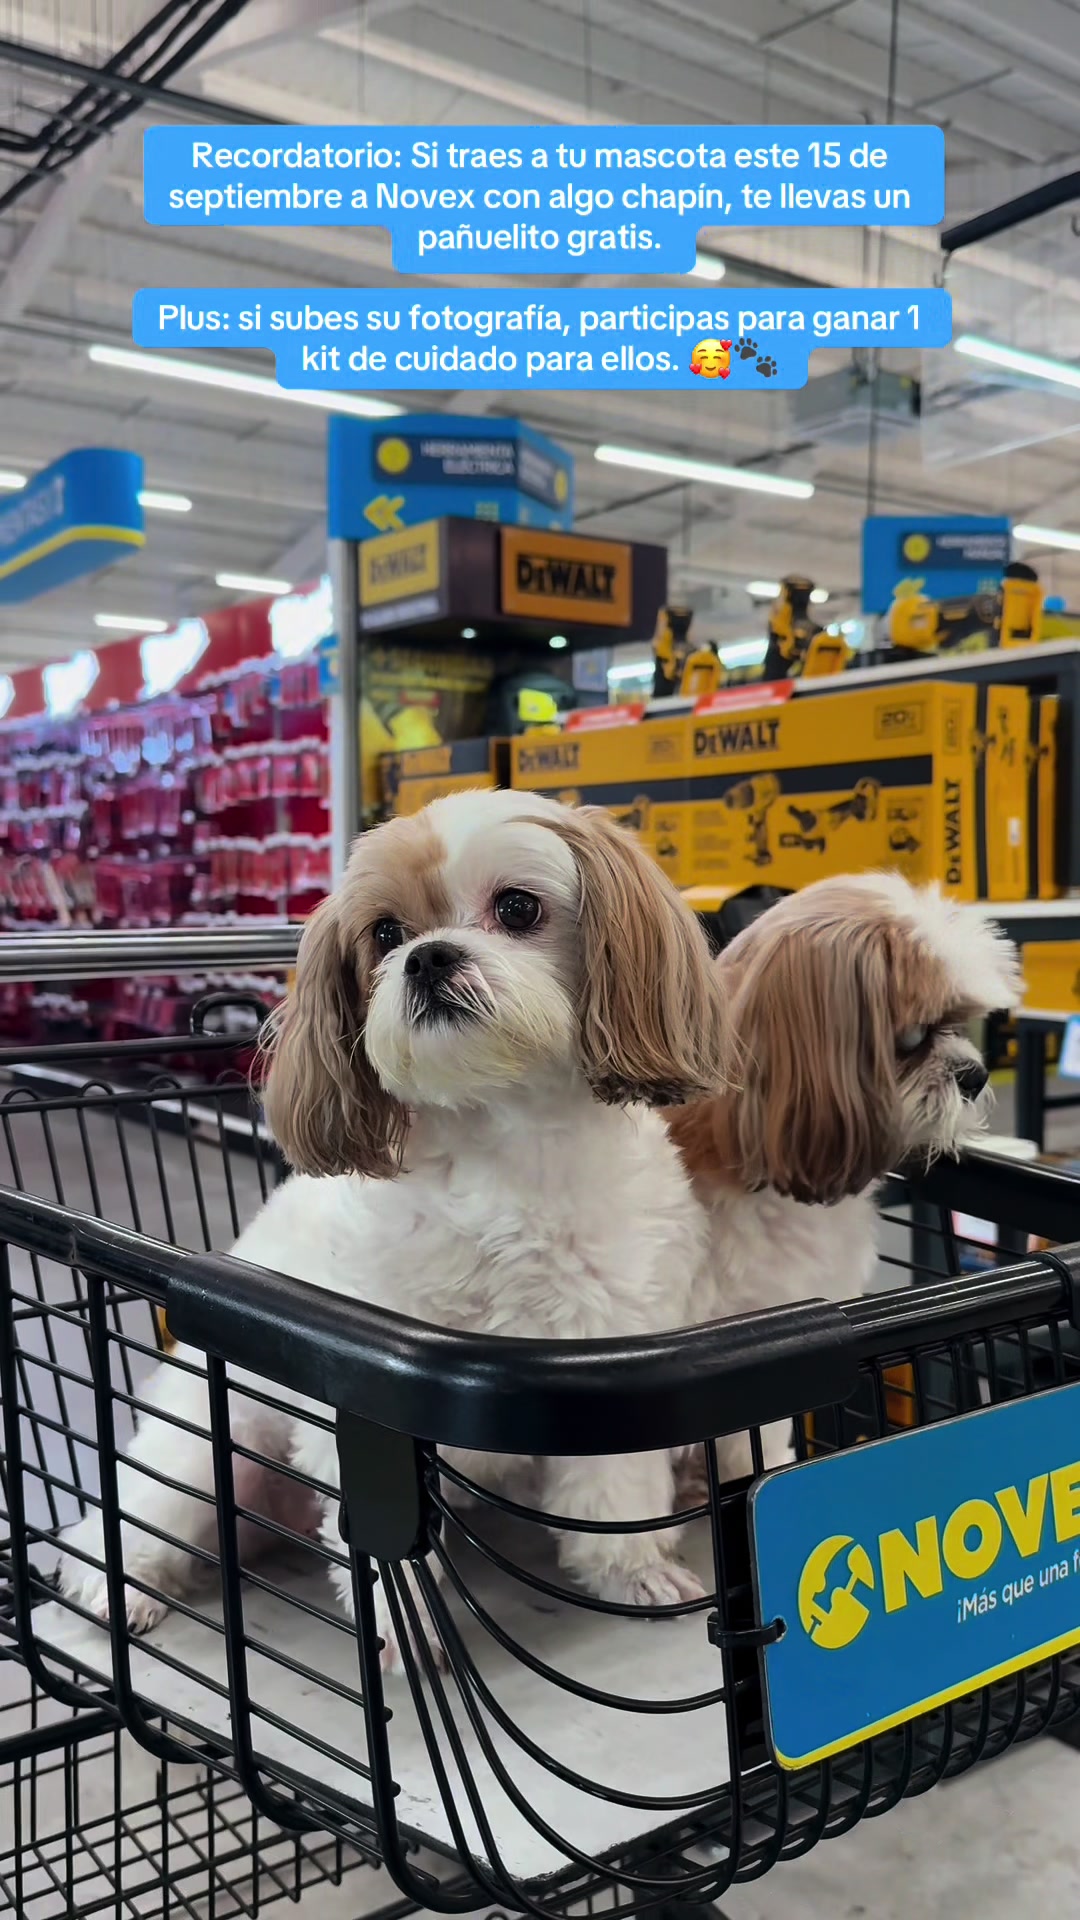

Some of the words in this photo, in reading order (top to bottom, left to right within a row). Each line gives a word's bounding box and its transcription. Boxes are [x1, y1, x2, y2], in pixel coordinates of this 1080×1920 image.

[956, 1586, 997, 1624] ¡Más
[1001, 1574, 1035, 1607] que
[1038, 1558, 1069, 1588] una
